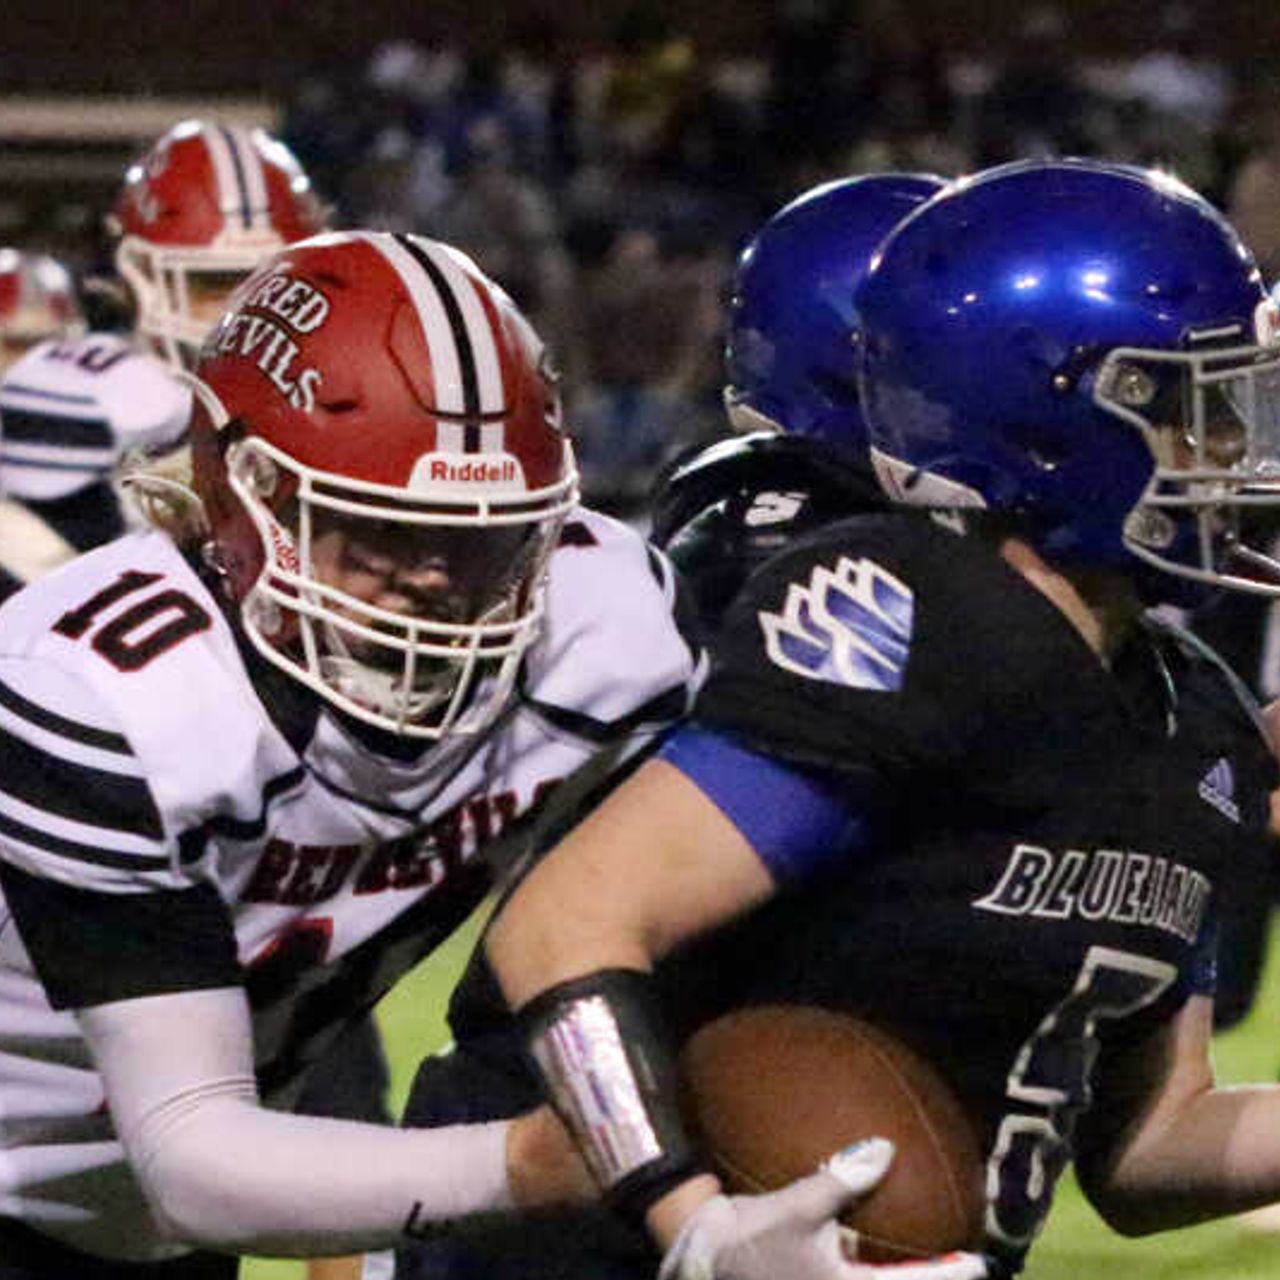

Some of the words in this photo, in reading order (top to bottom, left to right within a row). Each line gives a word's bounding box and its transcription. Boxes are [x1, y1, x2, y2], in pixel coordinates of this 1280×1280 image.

[218, 311, 322, 414] EVILS
[430, 460, 515, 482] Riddell
[50, 569, 213, 673] 10
[237, 837, 363, 905] RED
